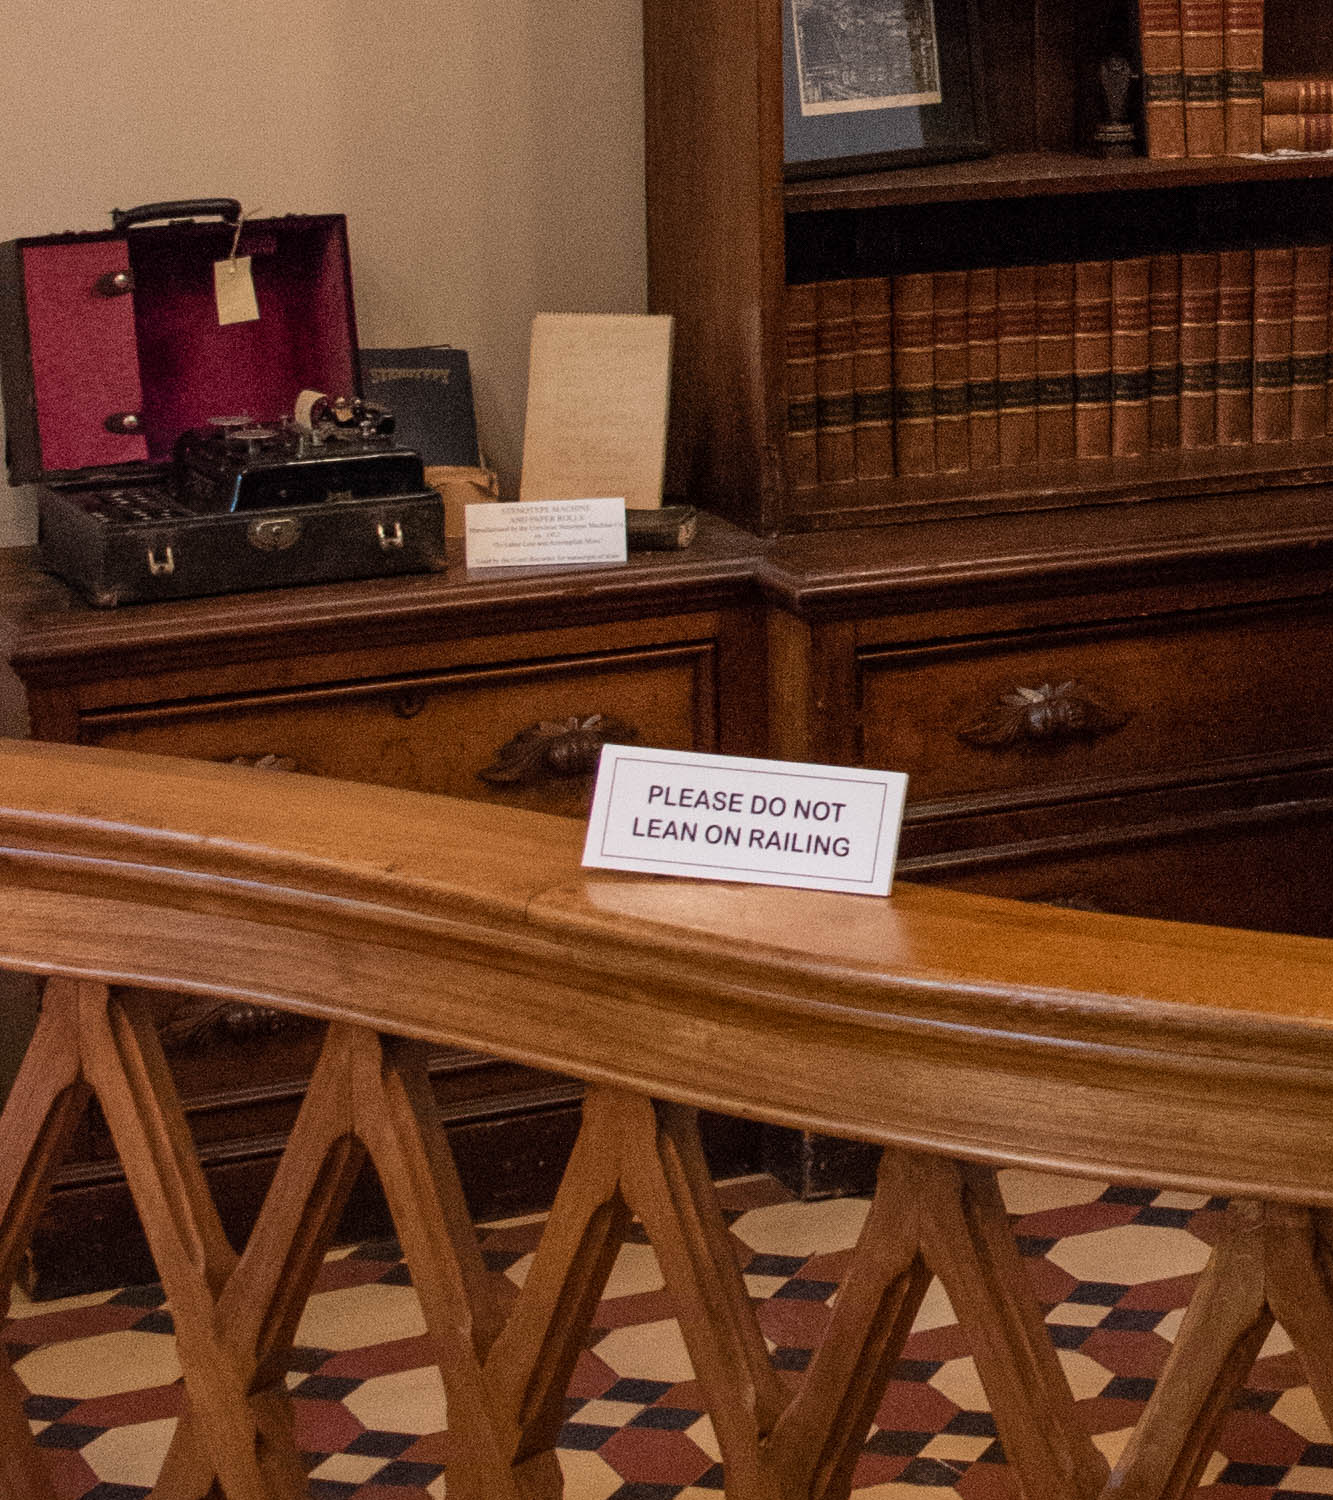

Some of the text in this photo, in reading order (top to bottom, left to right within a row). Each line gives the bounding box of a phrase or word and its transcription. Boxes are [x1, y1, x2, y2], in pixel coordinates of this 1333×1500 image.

[647, 785, 846, 823] PLEASE DO NOT
[632, 817, 850, 857] LEAN ON RAILING
